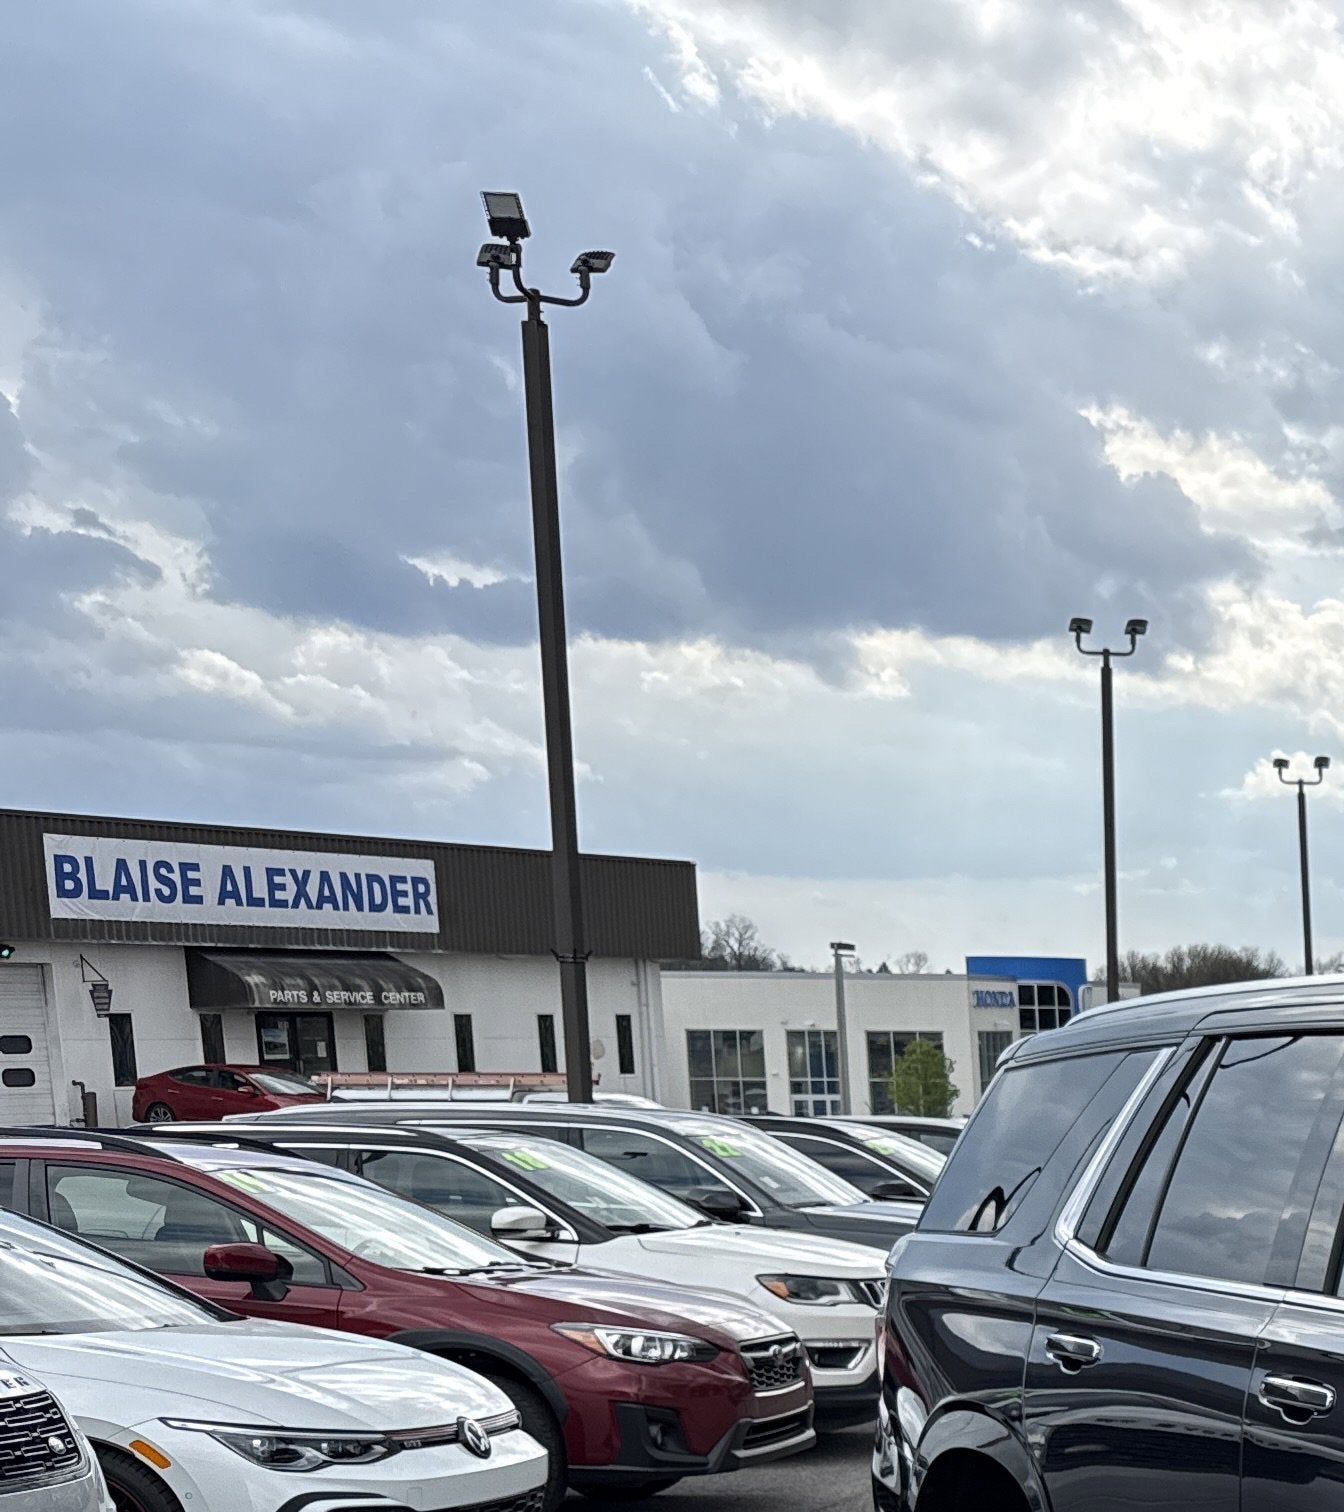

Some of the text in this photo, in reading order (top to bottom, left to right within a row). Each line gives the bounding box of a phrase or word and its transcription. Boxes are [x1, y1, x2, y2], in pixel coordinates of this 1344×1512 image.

[53, 853, 434, 916] BLAISE ALEXANDER
[269, 989, 425, 1005] PARTS & SERVICE CENTER
[974, 990, 1016, 1008] HONDA
